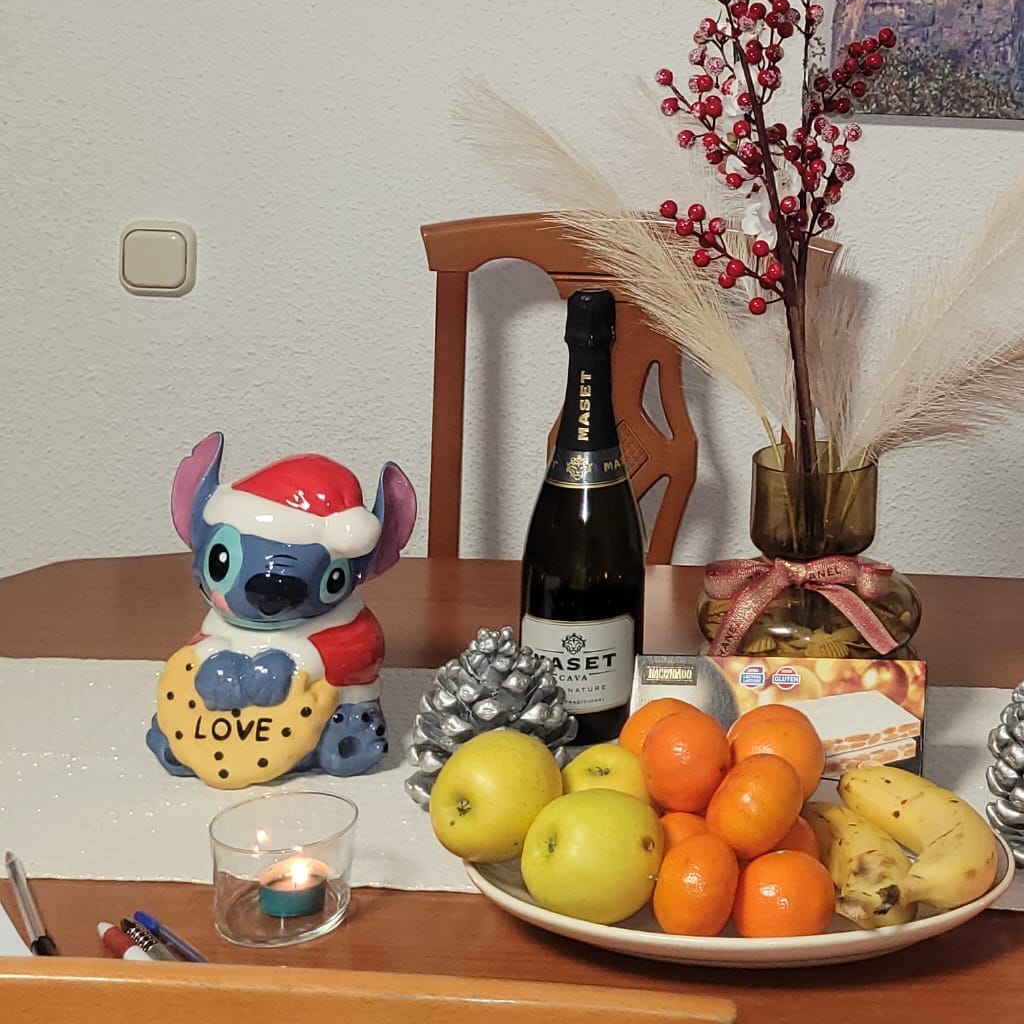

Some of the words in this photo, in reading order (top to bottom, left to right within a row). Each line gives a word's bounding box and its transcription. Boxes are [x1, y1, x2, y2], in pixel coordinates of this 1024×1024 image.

[577, 370, 592, 442] MASET
[568, 685, 607, 694] NATURE
[194, 715, 273, 742] LOVE
